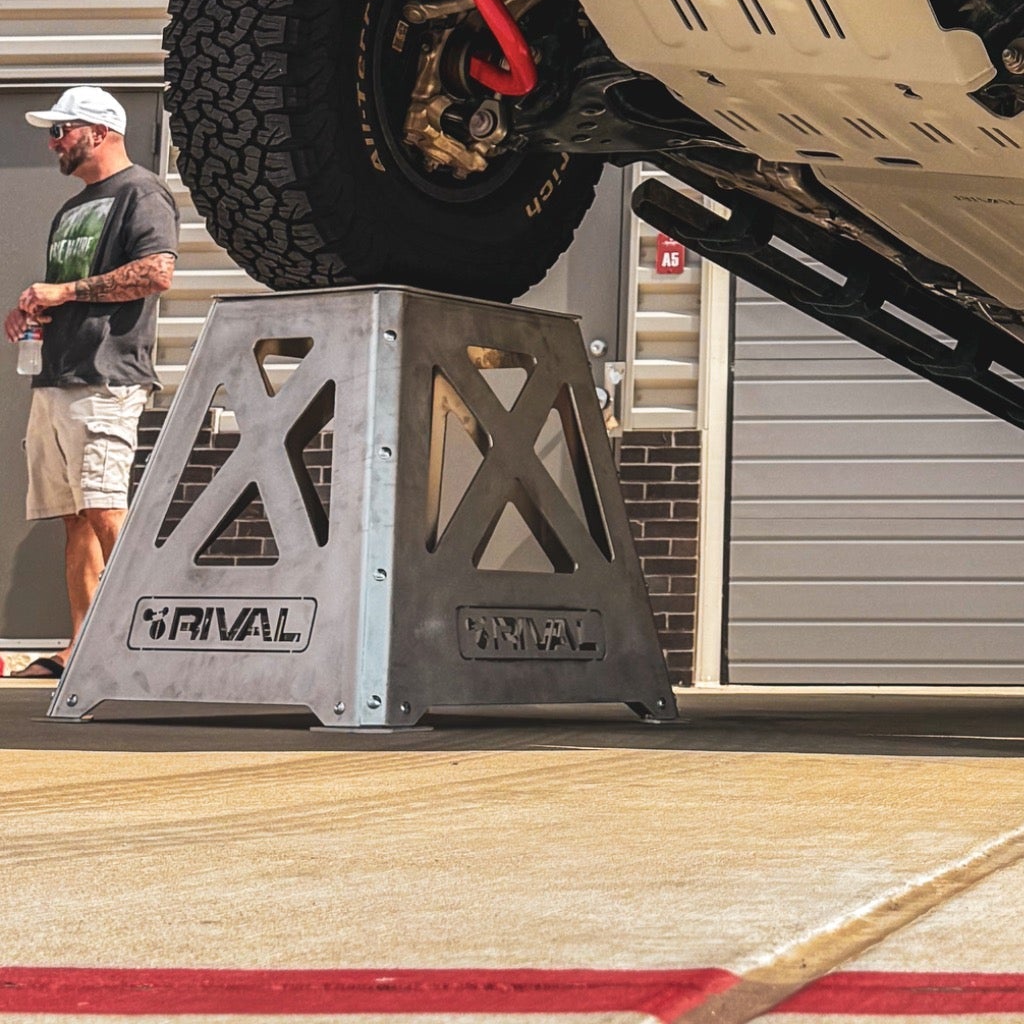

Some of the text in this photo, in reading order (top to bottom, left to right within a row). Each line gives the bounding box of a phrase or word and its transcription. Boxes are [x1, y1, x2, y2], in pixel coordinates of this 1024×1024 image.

[660, 251, 681, 268] A5
[168, 606, 302, 642] RIVAL
[491, 616, 598, 651] RIVAL
